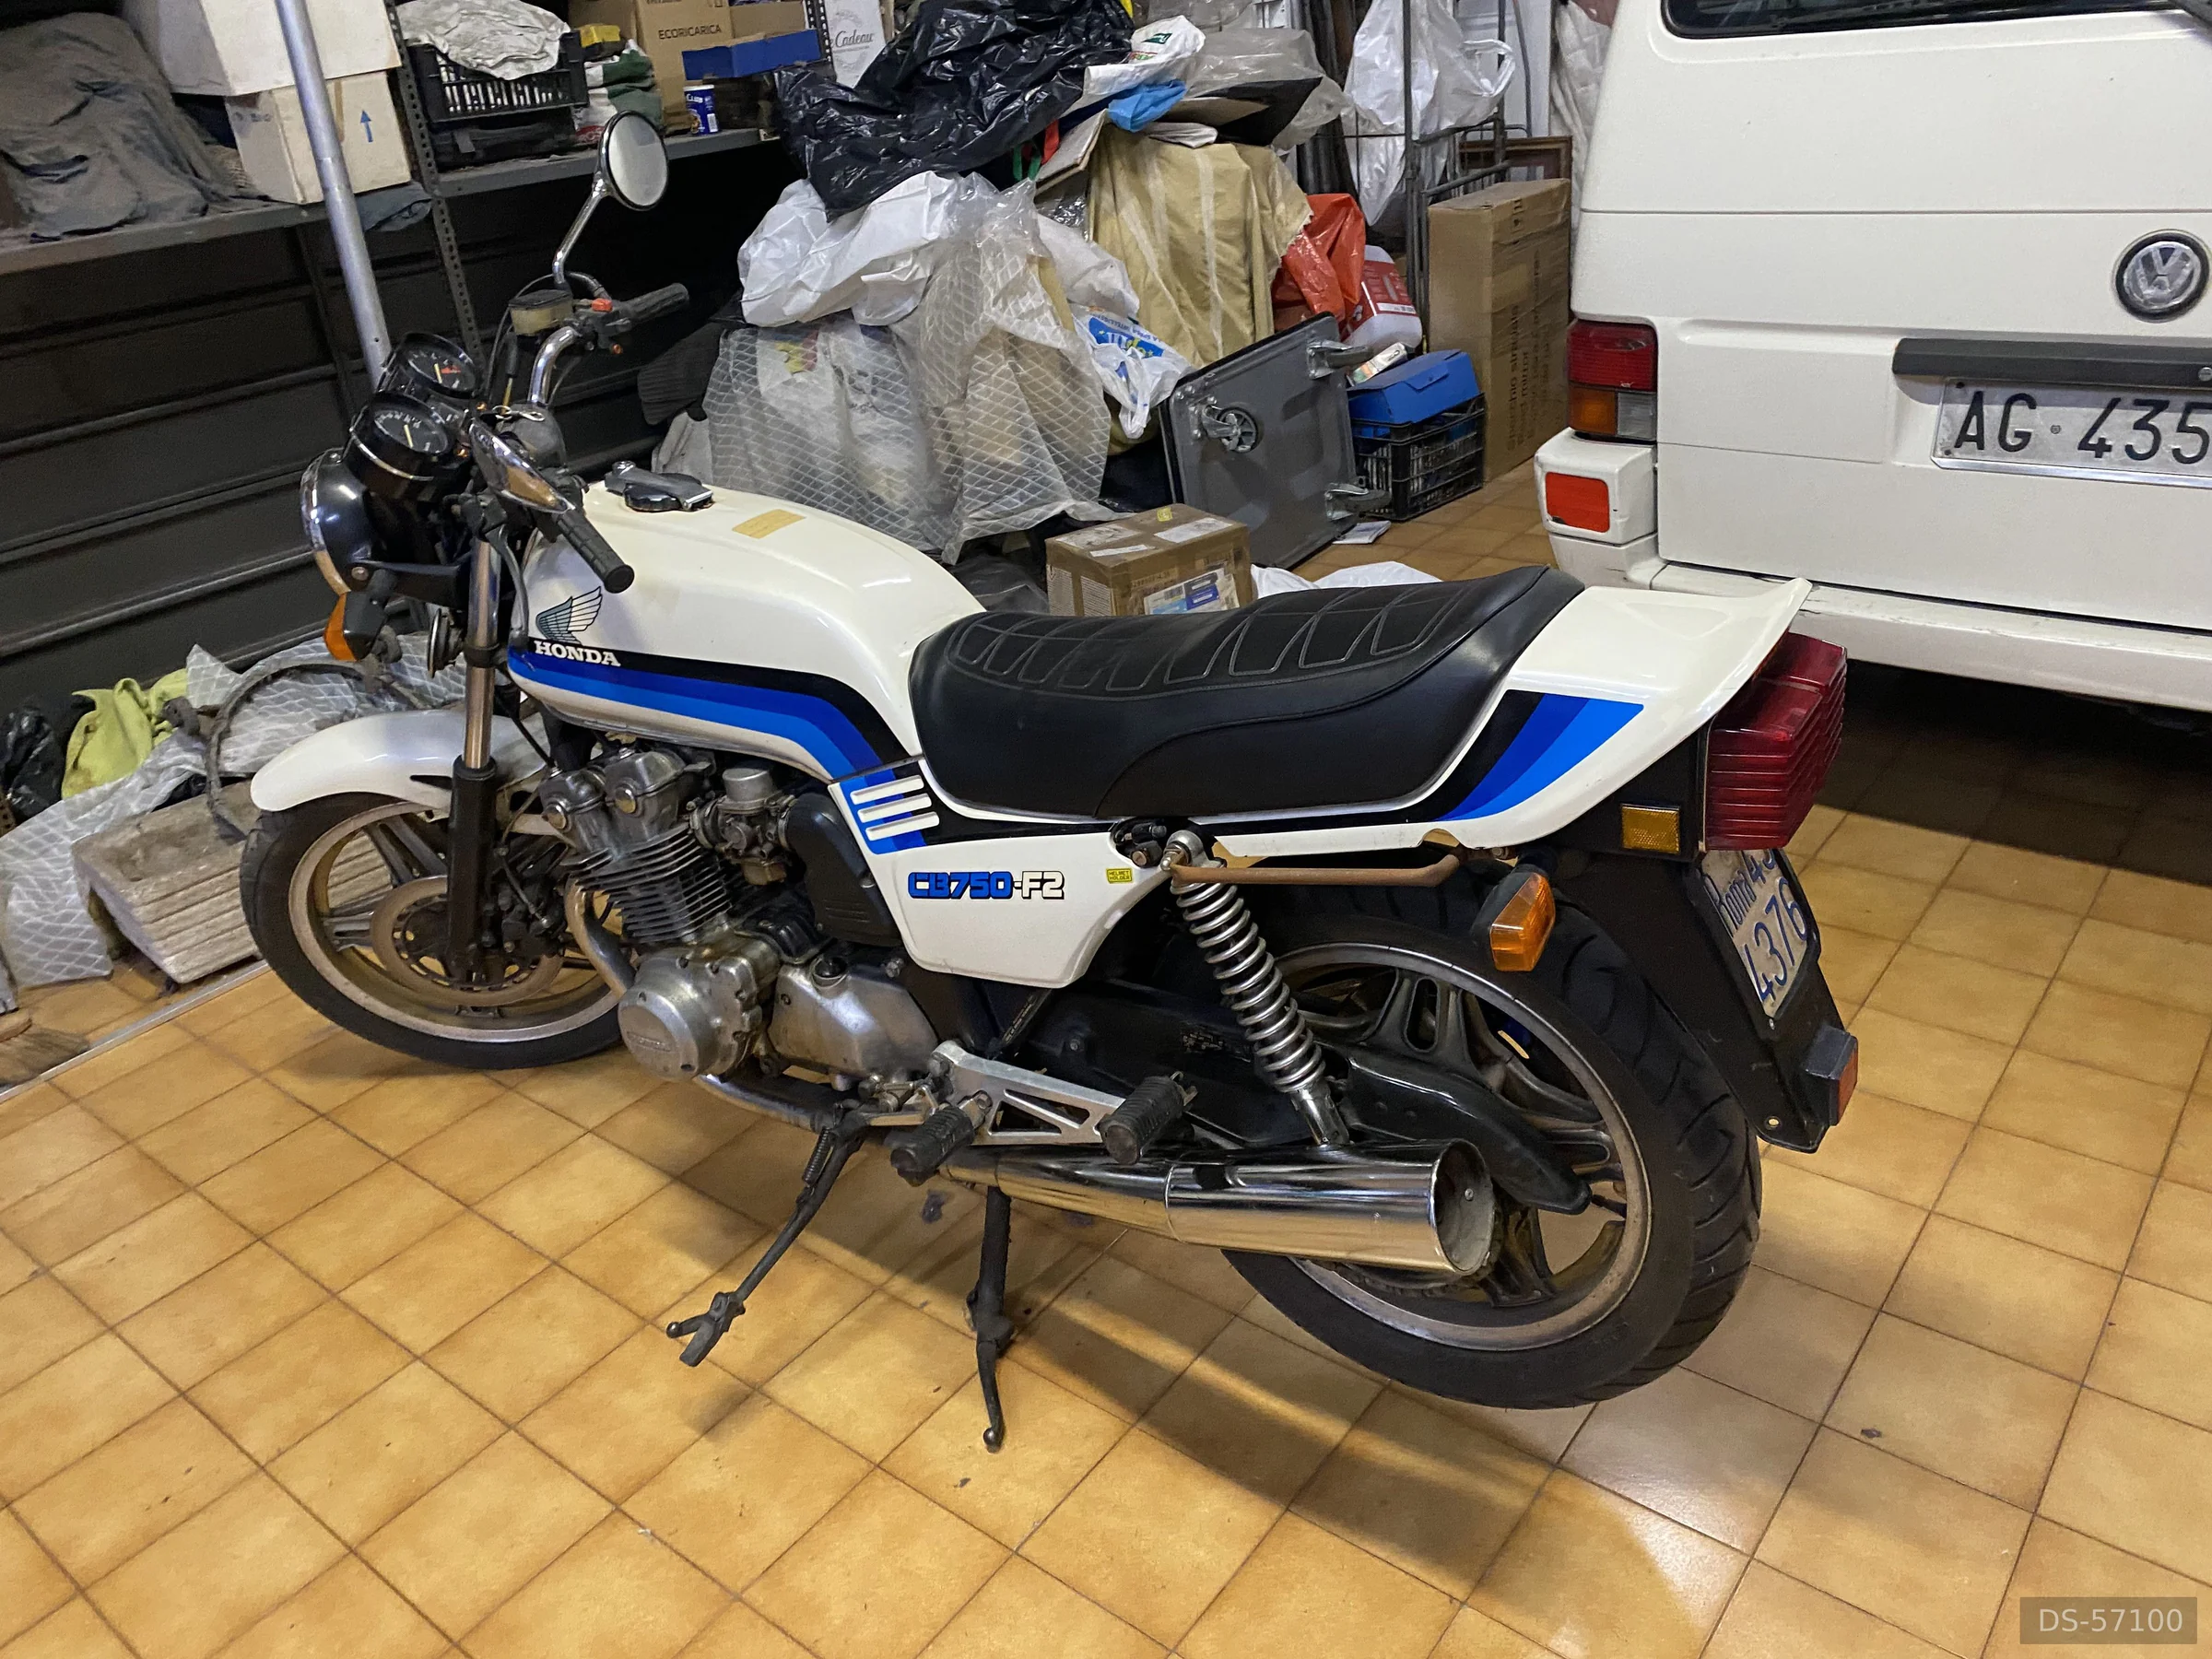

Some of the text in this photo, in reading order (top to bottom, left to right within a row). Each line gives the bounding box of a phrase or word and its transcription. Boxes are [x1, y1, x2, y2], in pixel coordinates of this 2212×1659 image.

[658, 24, 722, 40] ECORICARICA
[835, 29, 875, 48] Cadeau
[1954, 391, 2212, 465] AG 435
[534, 640, 621, 667] HONDA
[908, 871, 1065, 900] CB750-F2
[1744, 877, 1808, 1005] 4376
